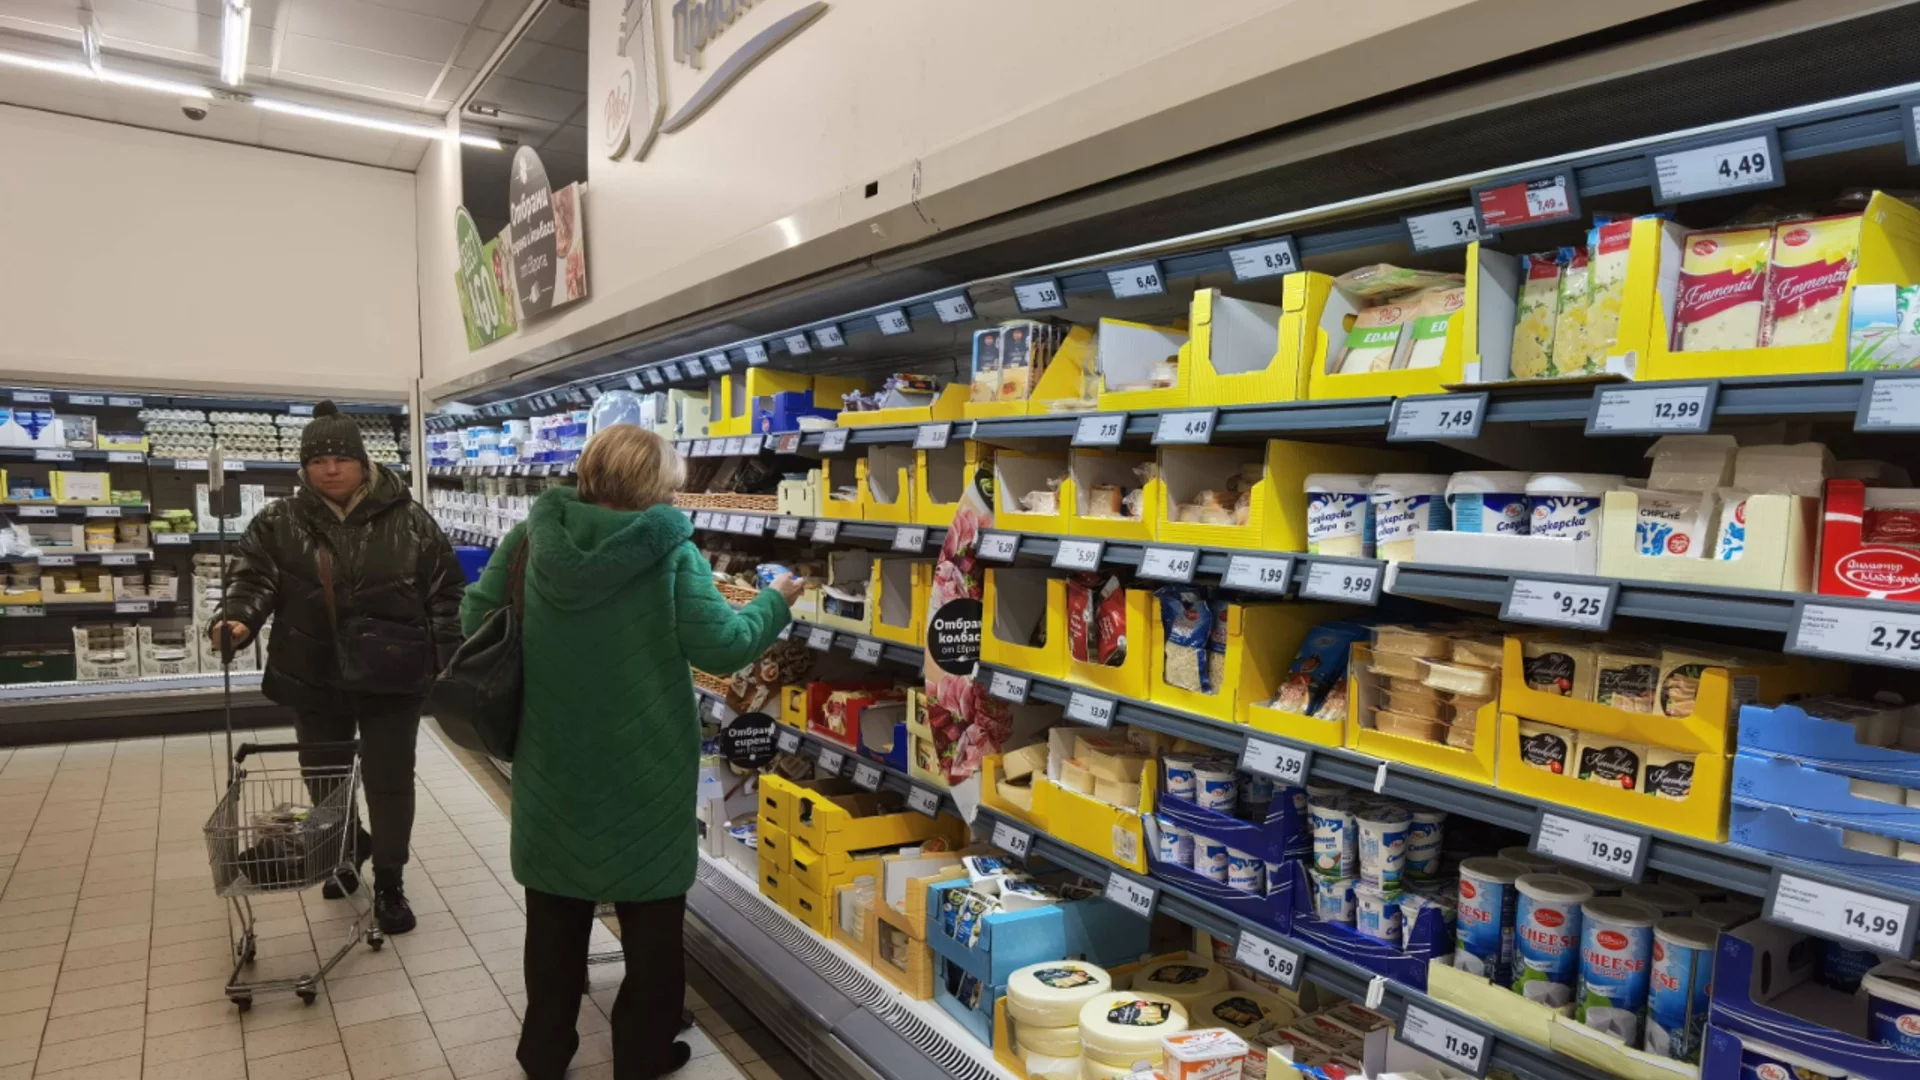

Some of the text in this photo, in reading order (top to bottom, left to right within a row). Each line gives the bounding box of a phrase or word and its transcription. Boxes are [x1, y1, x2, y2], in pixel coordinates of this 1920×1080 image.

[1719, 153, 1765, 179] 4,49
[1536, 198, 1556, 211] 7,49
[1451, 218, 1477, 237] 3,4
[1264, 252, 1291, 269] 8,99
[1136, 274, 1158, 289] 6,49
[1685, 269, 1762, 308] Emmental
[1430, 321, 1448, 333] ED
[1363, 331, 1399, 343] EDAM
[1438, 410, 1473, 429] 7,49
[1655, 402, 1699, 420] 12,99
[1184, 421, 1207, 435] 4,49
[1167, 557, 1190, 572] 4,49
[1259, 567, 1282, 583] 1,99
[1343, 576, 1372, 594] 9,99
[1560, 595, 1601, 616] 9,25
[1870, 626, 1920, 651] 2,79
[1274, 756, 1302, 775] 2,99
[1590, 840, 1633, 864] 19,99
[1844, 909, 1899, 936] 14,99
[1519, 924, 1580, 948] CHEESE
[1267, 957, 1294, 976] 6,69
[1582, 947, 1645, 972] CHEESE
[1444, 1035, 1479, 1060] 11,99
